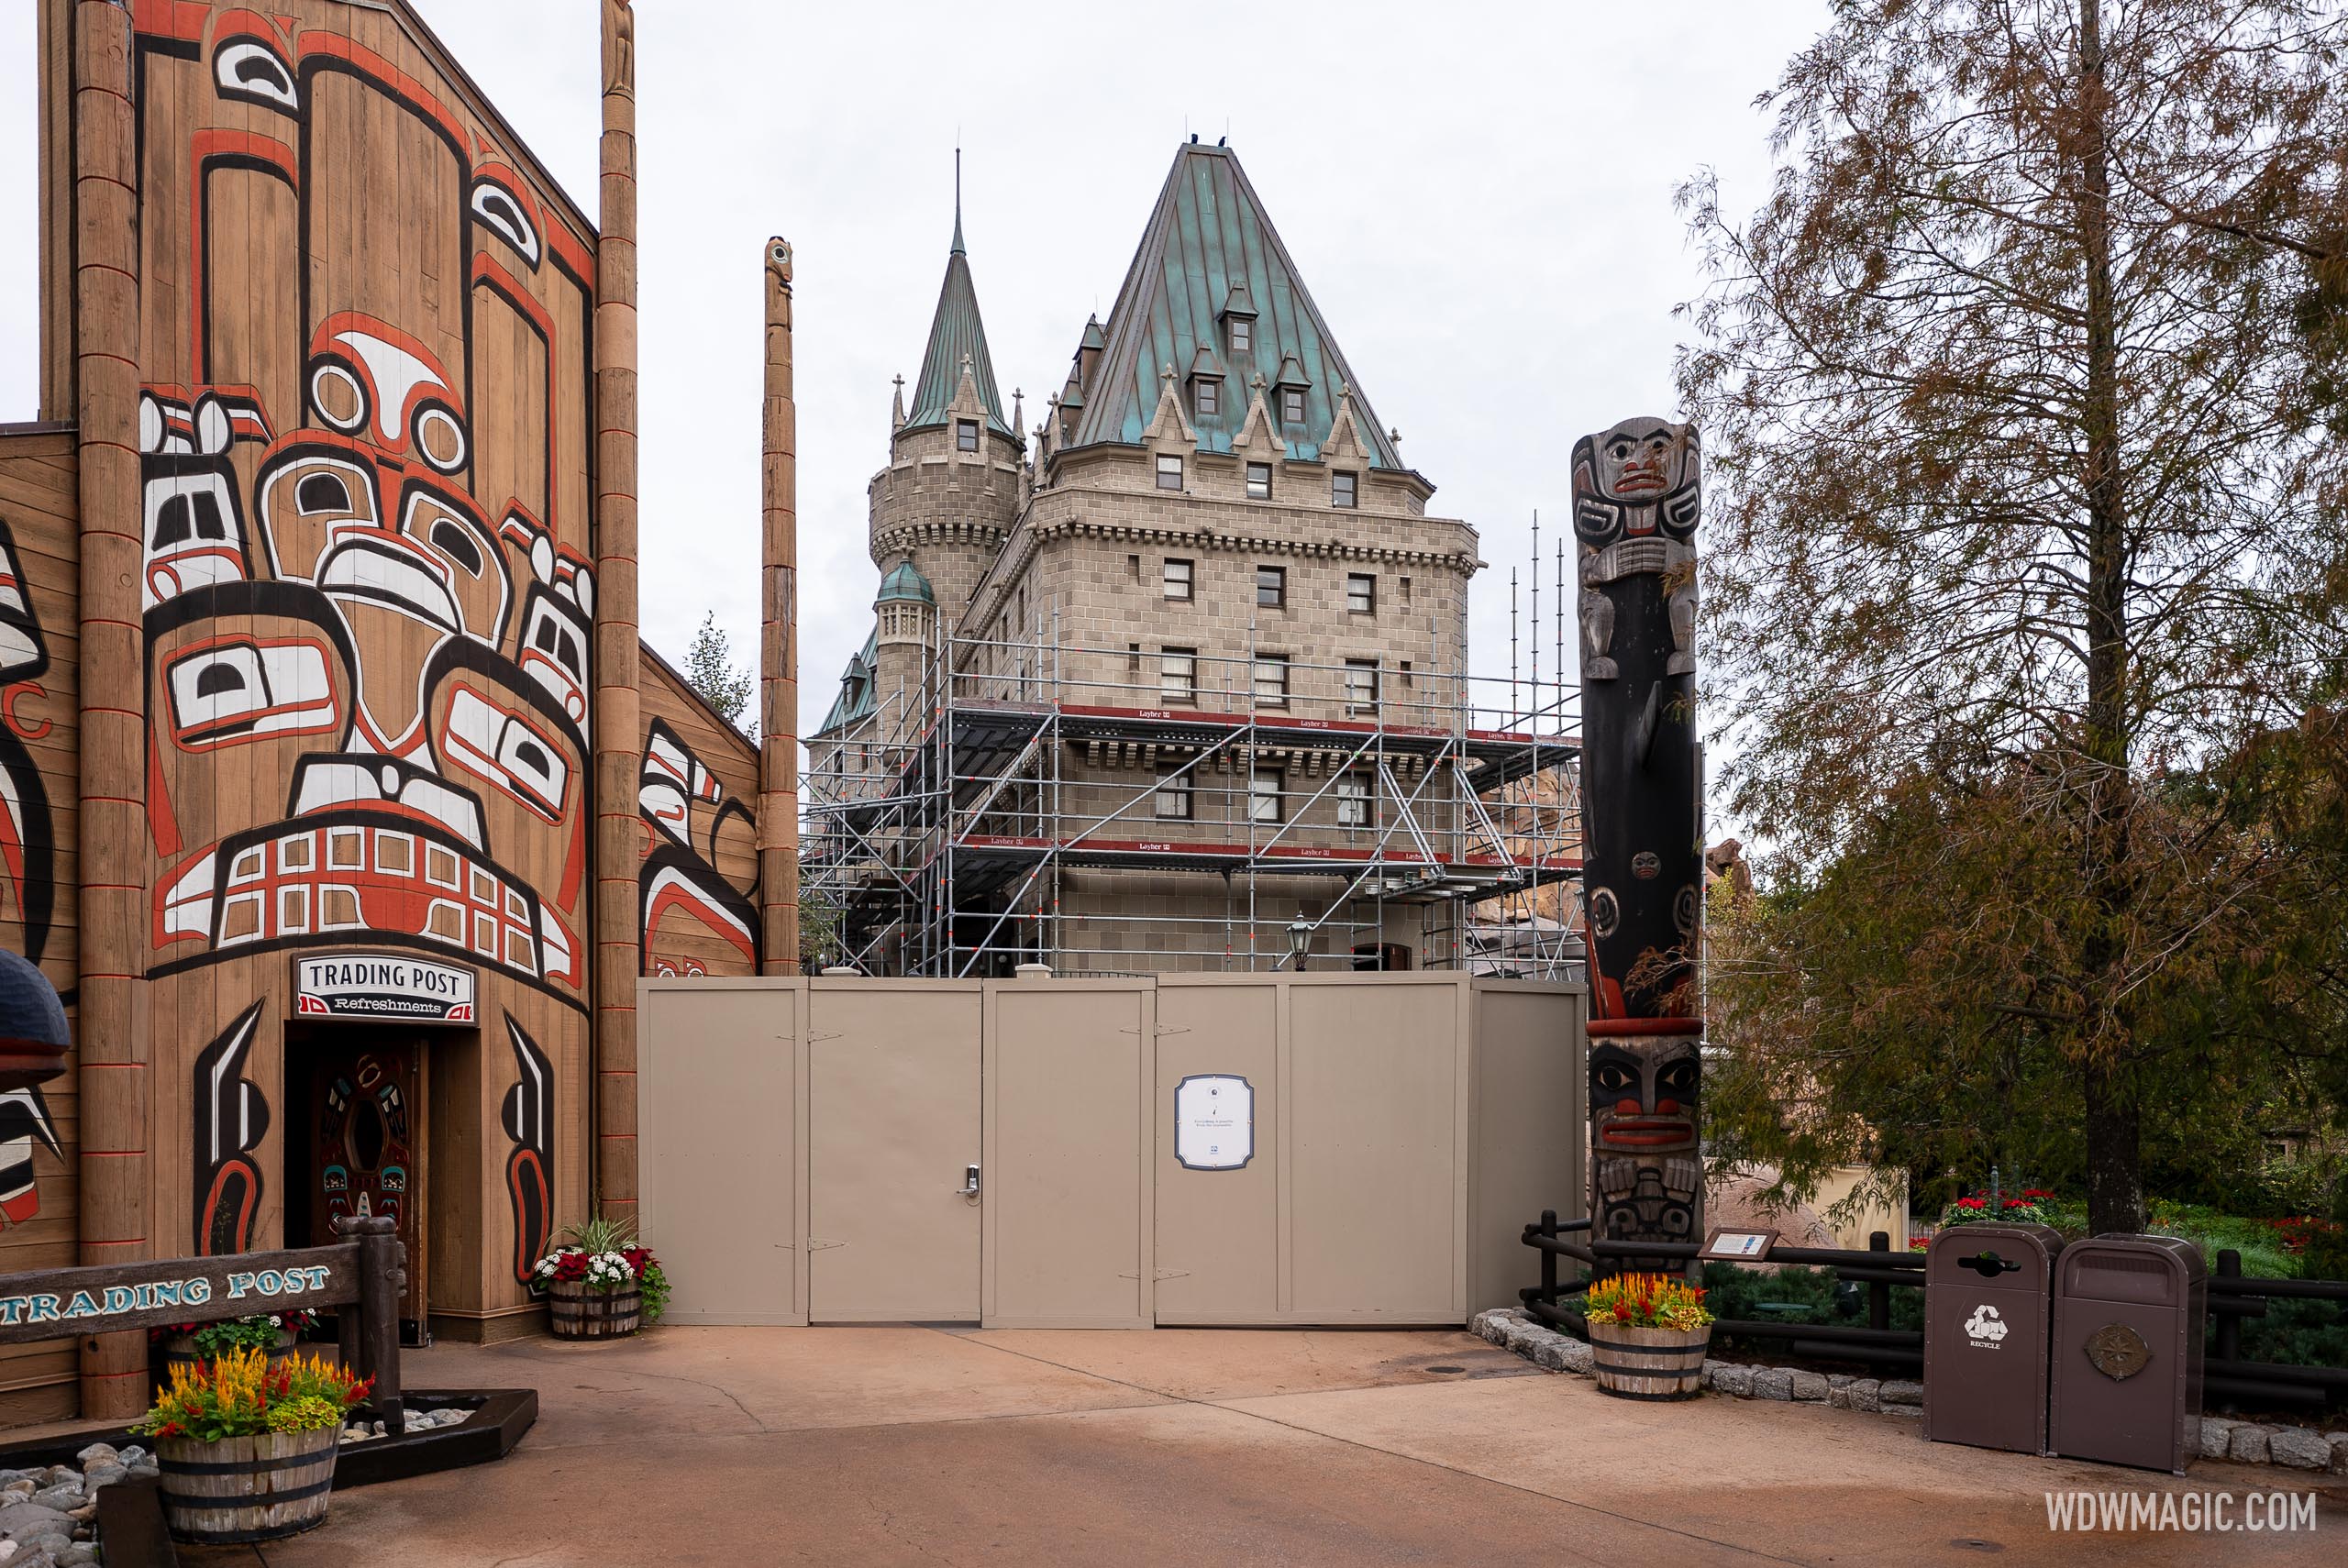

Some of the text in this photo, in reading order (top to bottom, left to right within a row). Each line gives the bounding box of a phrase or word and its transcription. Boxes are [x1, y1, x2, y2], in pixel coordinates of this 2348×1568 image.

[1139, 710, 1162, 718] Layher
[991, 837, 1014, 845] Layher
[1139, 843, 1162, 851] Layher
[309, 964, 460, 996] TRADING POST
[334, 998, 442, 1013] Refreshments
[0, 1265, 331, 1326] TRADING POST
[1970, 1340, 2001, 1350] RECYCLE
